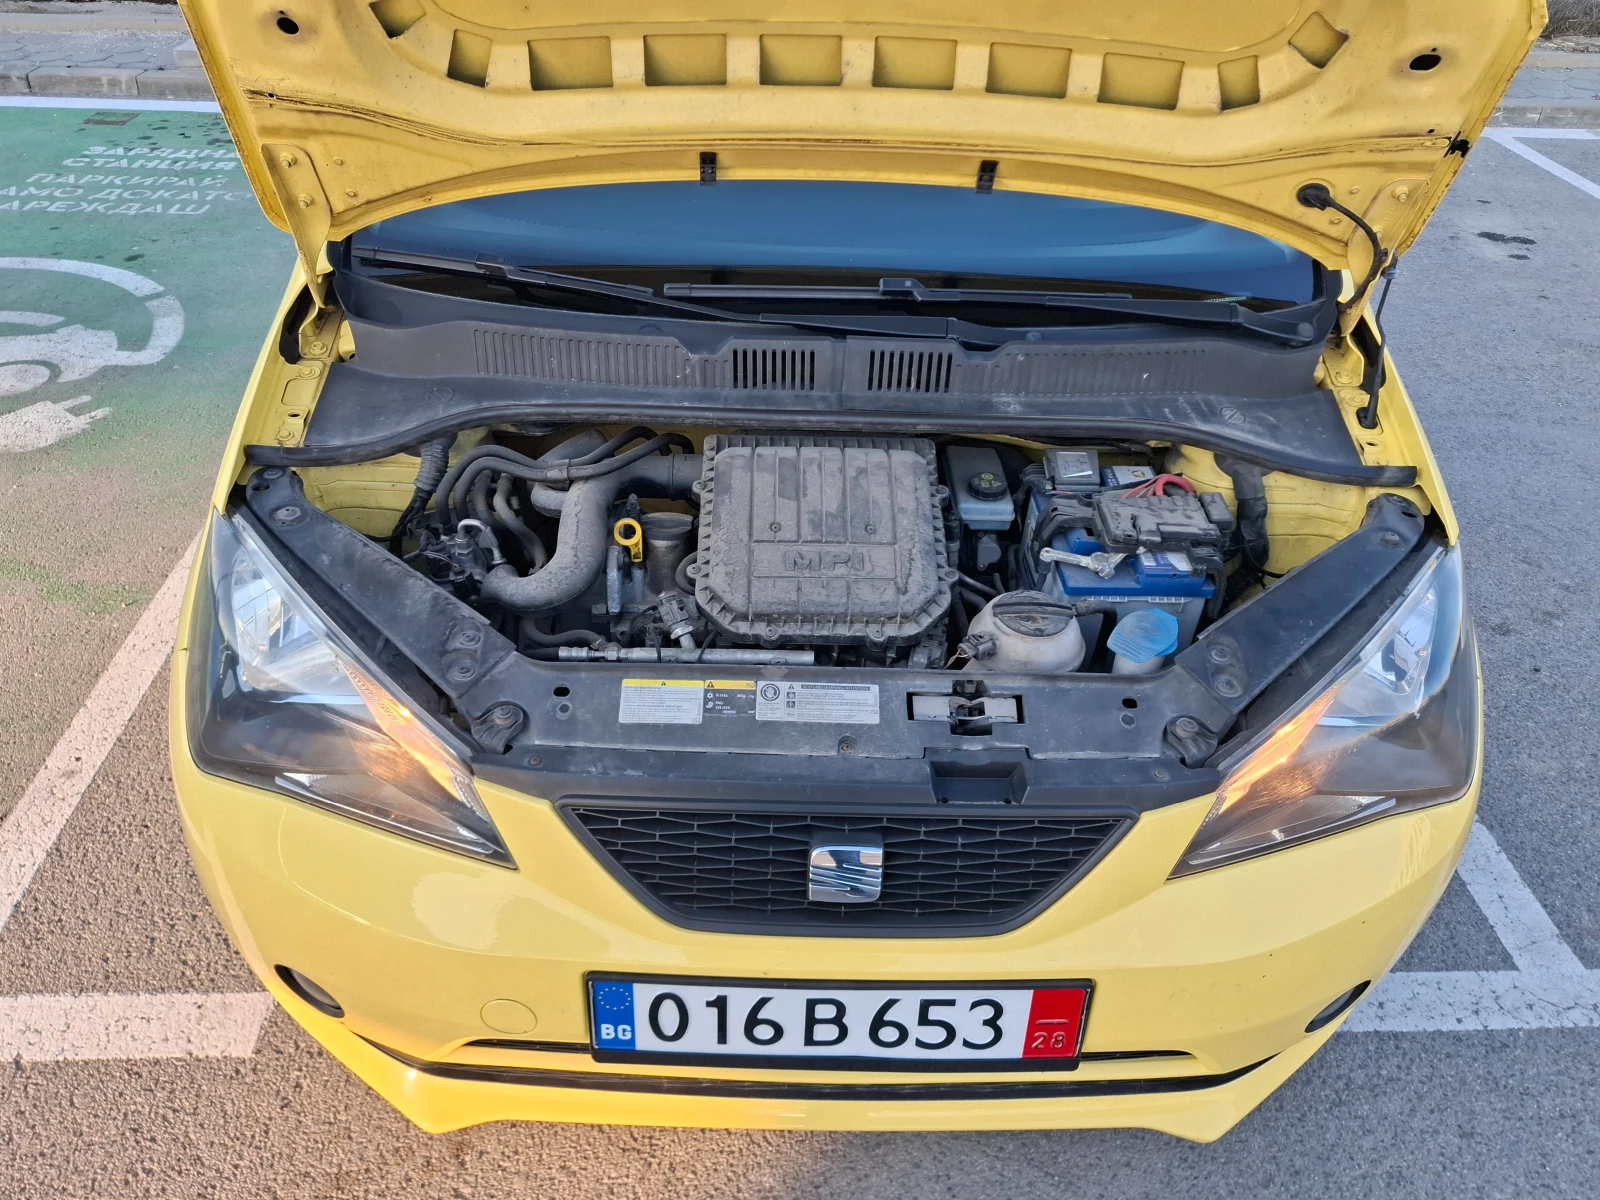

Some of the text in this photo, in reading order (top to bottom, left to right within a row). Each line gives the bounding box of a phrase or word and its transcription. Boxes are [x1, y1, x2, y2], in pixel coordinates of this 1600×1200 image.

[82, 146, 240, 159] ЗАРЯДНА
[62, 158, 238, 170] СТАНЦИЯ
[26, 173, 229, 187] ПАРКИРАЙ
[87, 188, 254, 201] ДОКАТО
[783, 550, 865, 572] MPI
[648, 992, 784, 1046] 016
[868, 996, 1004, 1050] 653
[601, 1023, 632, 1040] BG
[1031, 1031, 1067, 1049] 28
